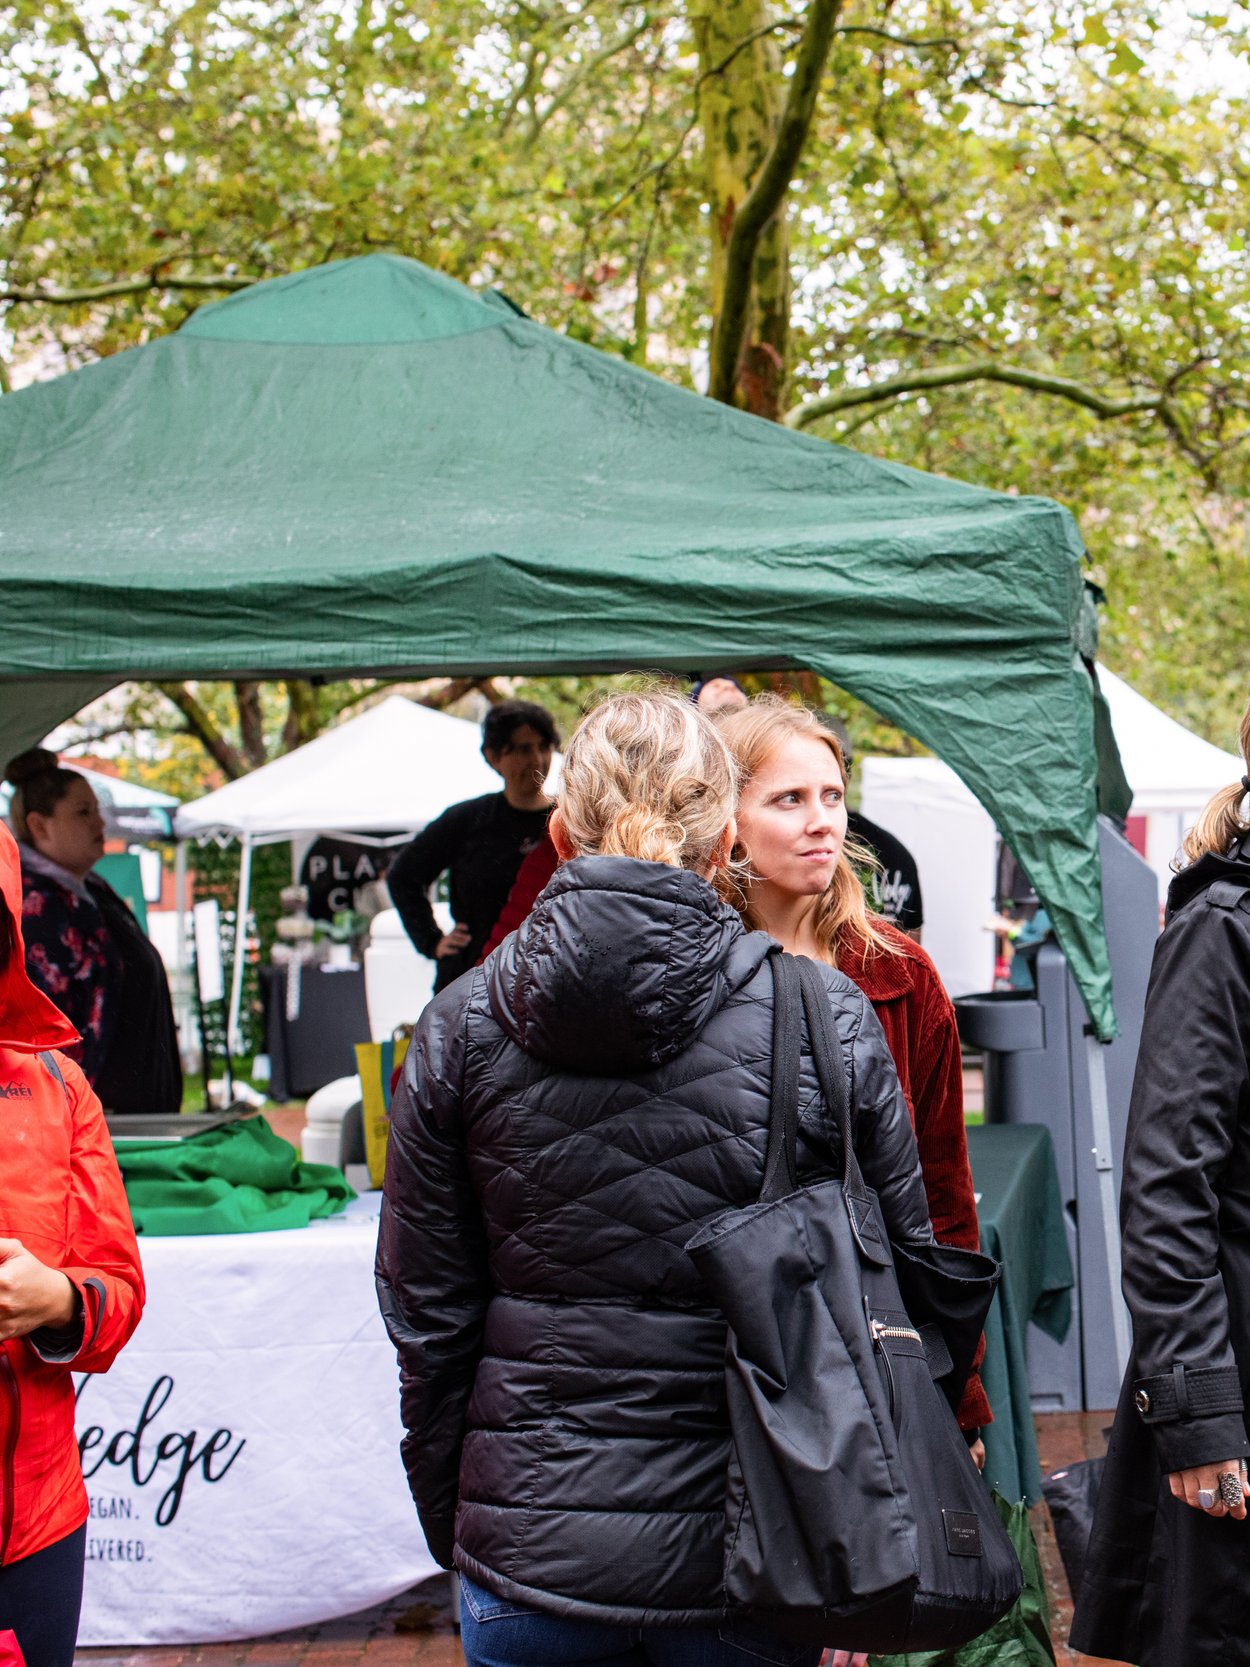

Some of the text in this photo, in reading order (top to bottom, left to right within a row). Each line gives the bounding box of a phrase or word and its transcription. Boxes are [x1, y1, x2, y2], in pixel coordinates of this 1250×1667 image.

[309, 853, 375, 880] PLA
[9, 1087, 32, 1097] REI
[89, 1498, 140, 1520] EGAN.
[85, 1538, 153, 1562] IVERED.
